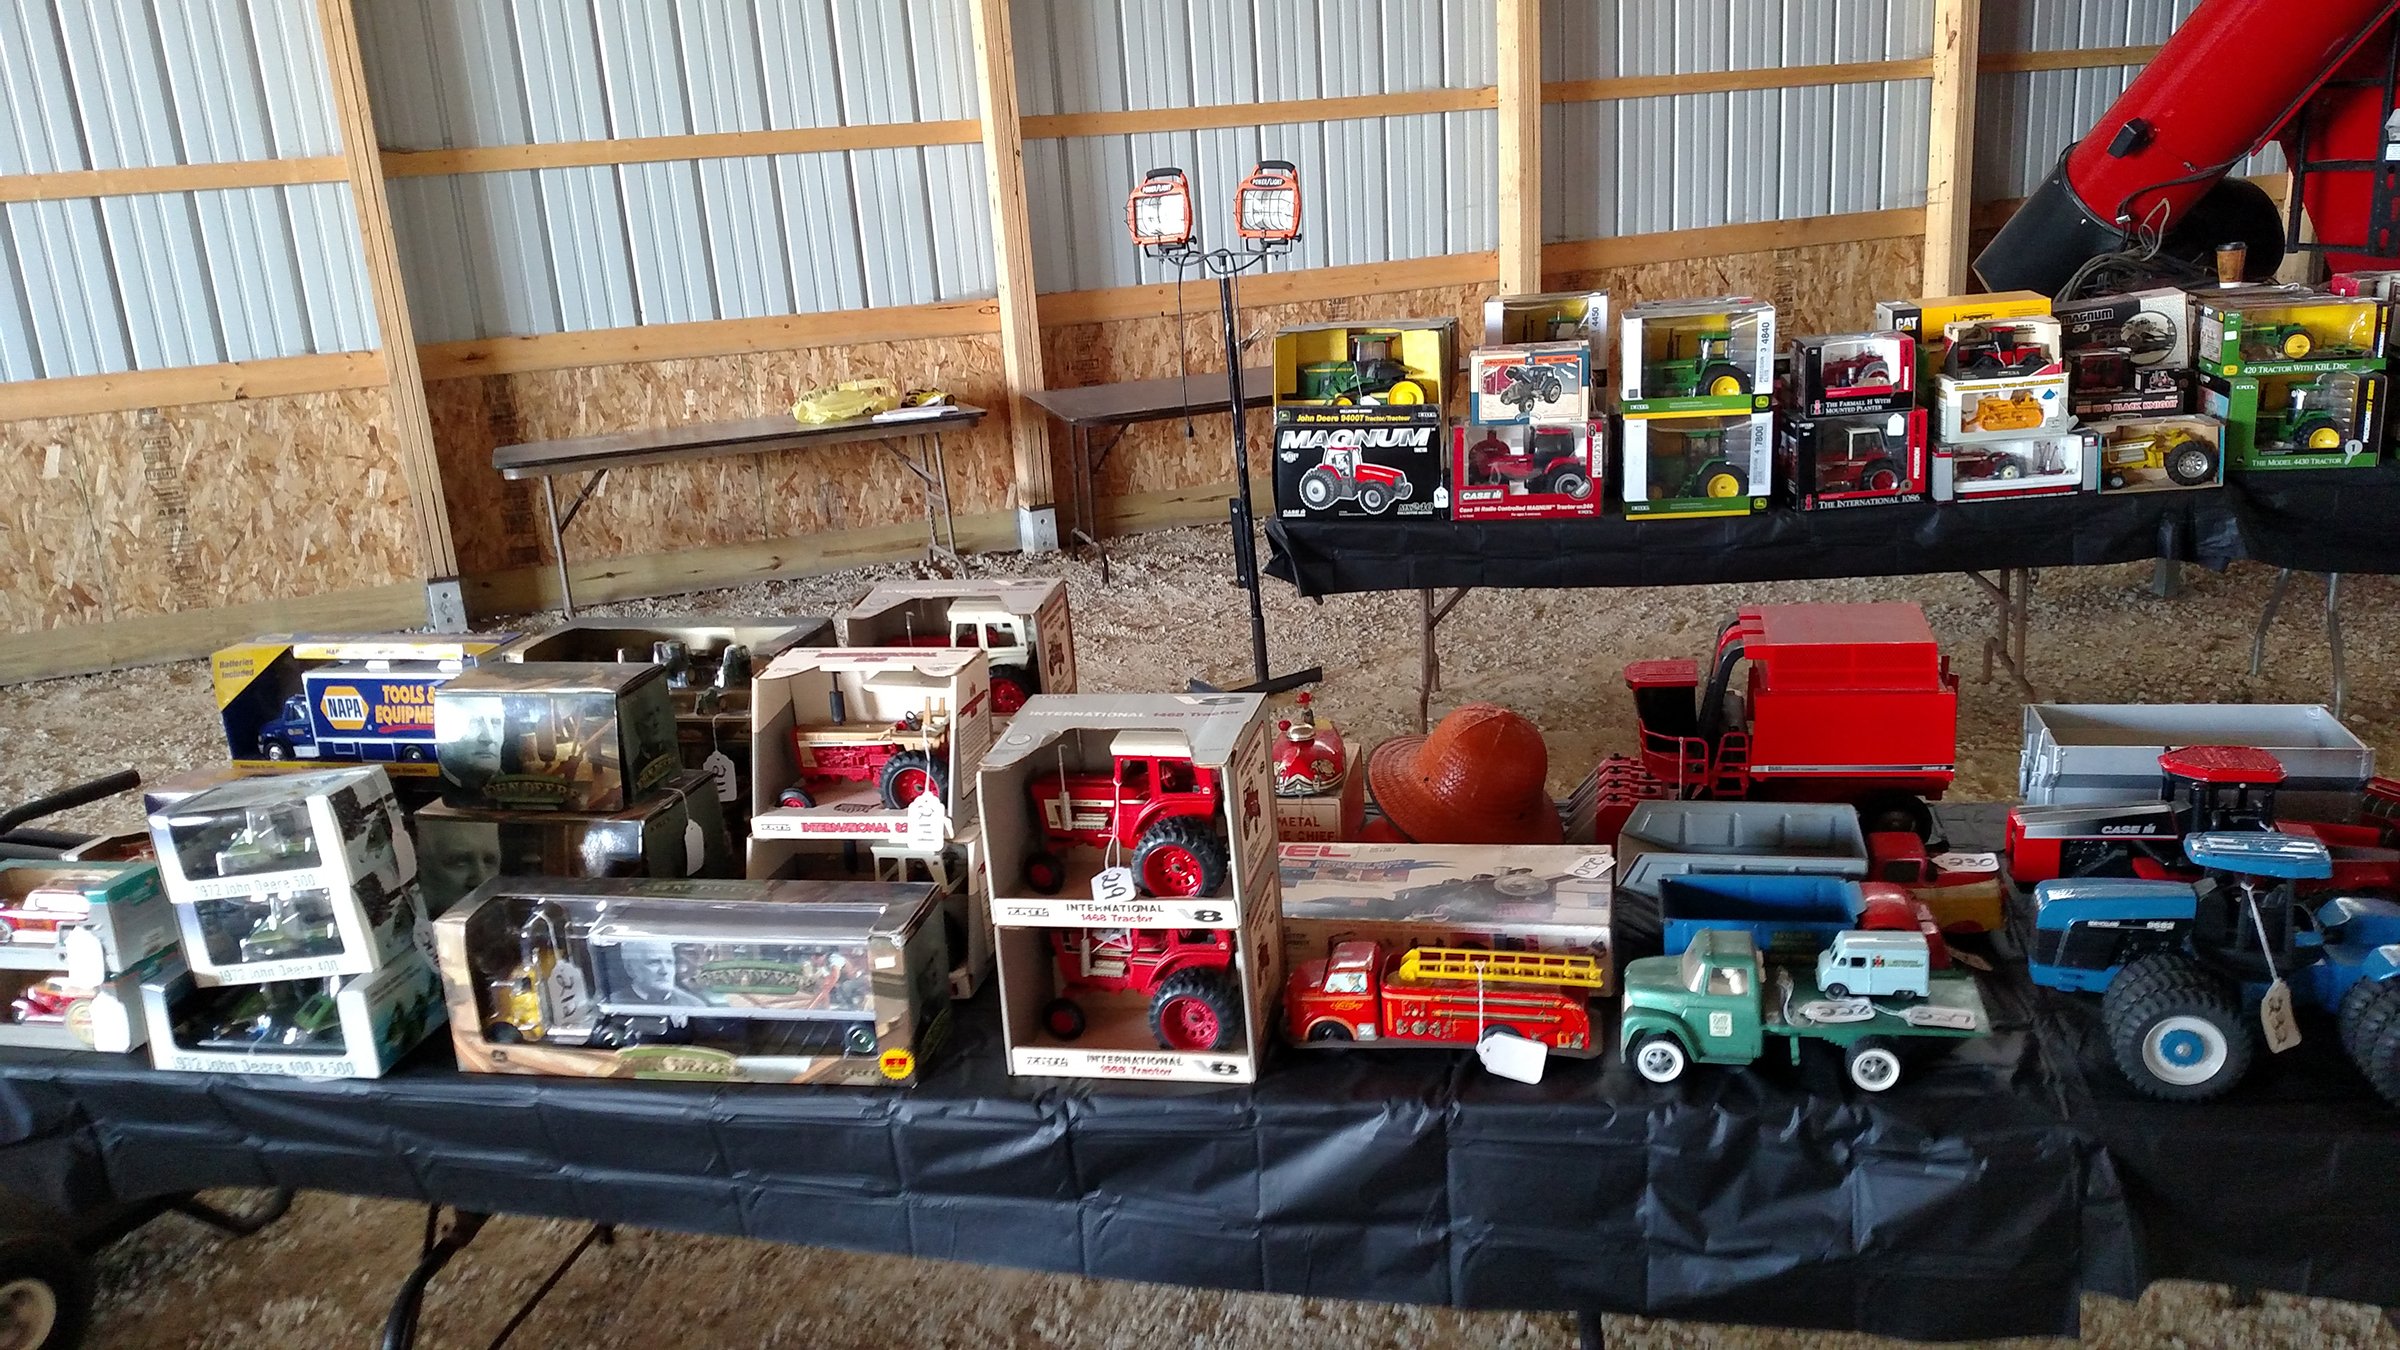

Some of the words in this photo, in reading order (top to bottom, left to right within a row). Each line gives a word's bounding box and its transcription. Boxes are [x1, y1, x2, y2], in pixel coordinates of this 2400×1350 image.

[1591, 306, 1600, 327] 4450
[2061, 308, 2114, 324] MAGNUM
[1895, 317, 1918, 331] CAT
[1760, 321, 1770, 346] 4840
[2243, 366, 2257, 375] 420
[2258, 365, 2292, 373] TRACTOR
[2293, 363, 2313, 372] WITH
[2315, 362, 2332, 371] KBL
[2333, 362, 2351, 371] DISC
[1839, 399, 1866, 407] FARMALL
[1874, 398, 1892, 406] WITH
[1825, 406, 1855, 414] MOUNTED
[1297, 415, 1315, 423] John
[1316, 414, 1340, 423] Deere
[1280, 428, 1431, 450] MAGNUM
[1754, 425, 1764, 447] 7800
[2252, 458, 2267, 467] THE
[2267, 457, 2292, 466] MODEL
[2310, 456, 2342, 465] TRACTOR
[1462, 491, 1491, 500] CASE
[1818, 501, 1836, 510] THE
[1836, 495, 1899, 508] INTERNATIONAL
[1900, 493, 1921, 503] 1086
[1282, 509, 1301, 517] CASE
[381, 685, 426, 704] TOOLS
[328, 698, 364, 719] NAPA
[375, 704, 435, 725] EQUIPME
[1029, 710, 1147, 718] INTERNATIONAL
[801, 822, 891, 834] INTERNATIONAL
[1277, 816, 1321, 828] METAL
[2101, 825, 2140, 835] CASE
[1298, 831, 1336, 842] CHIEF
[1066, 902, 1165, 913] INTERNATIONAL
[1110, 913, 1153, 923] Tractor
[1086, 1055, 1184, 1067] INTERNATIONAL
